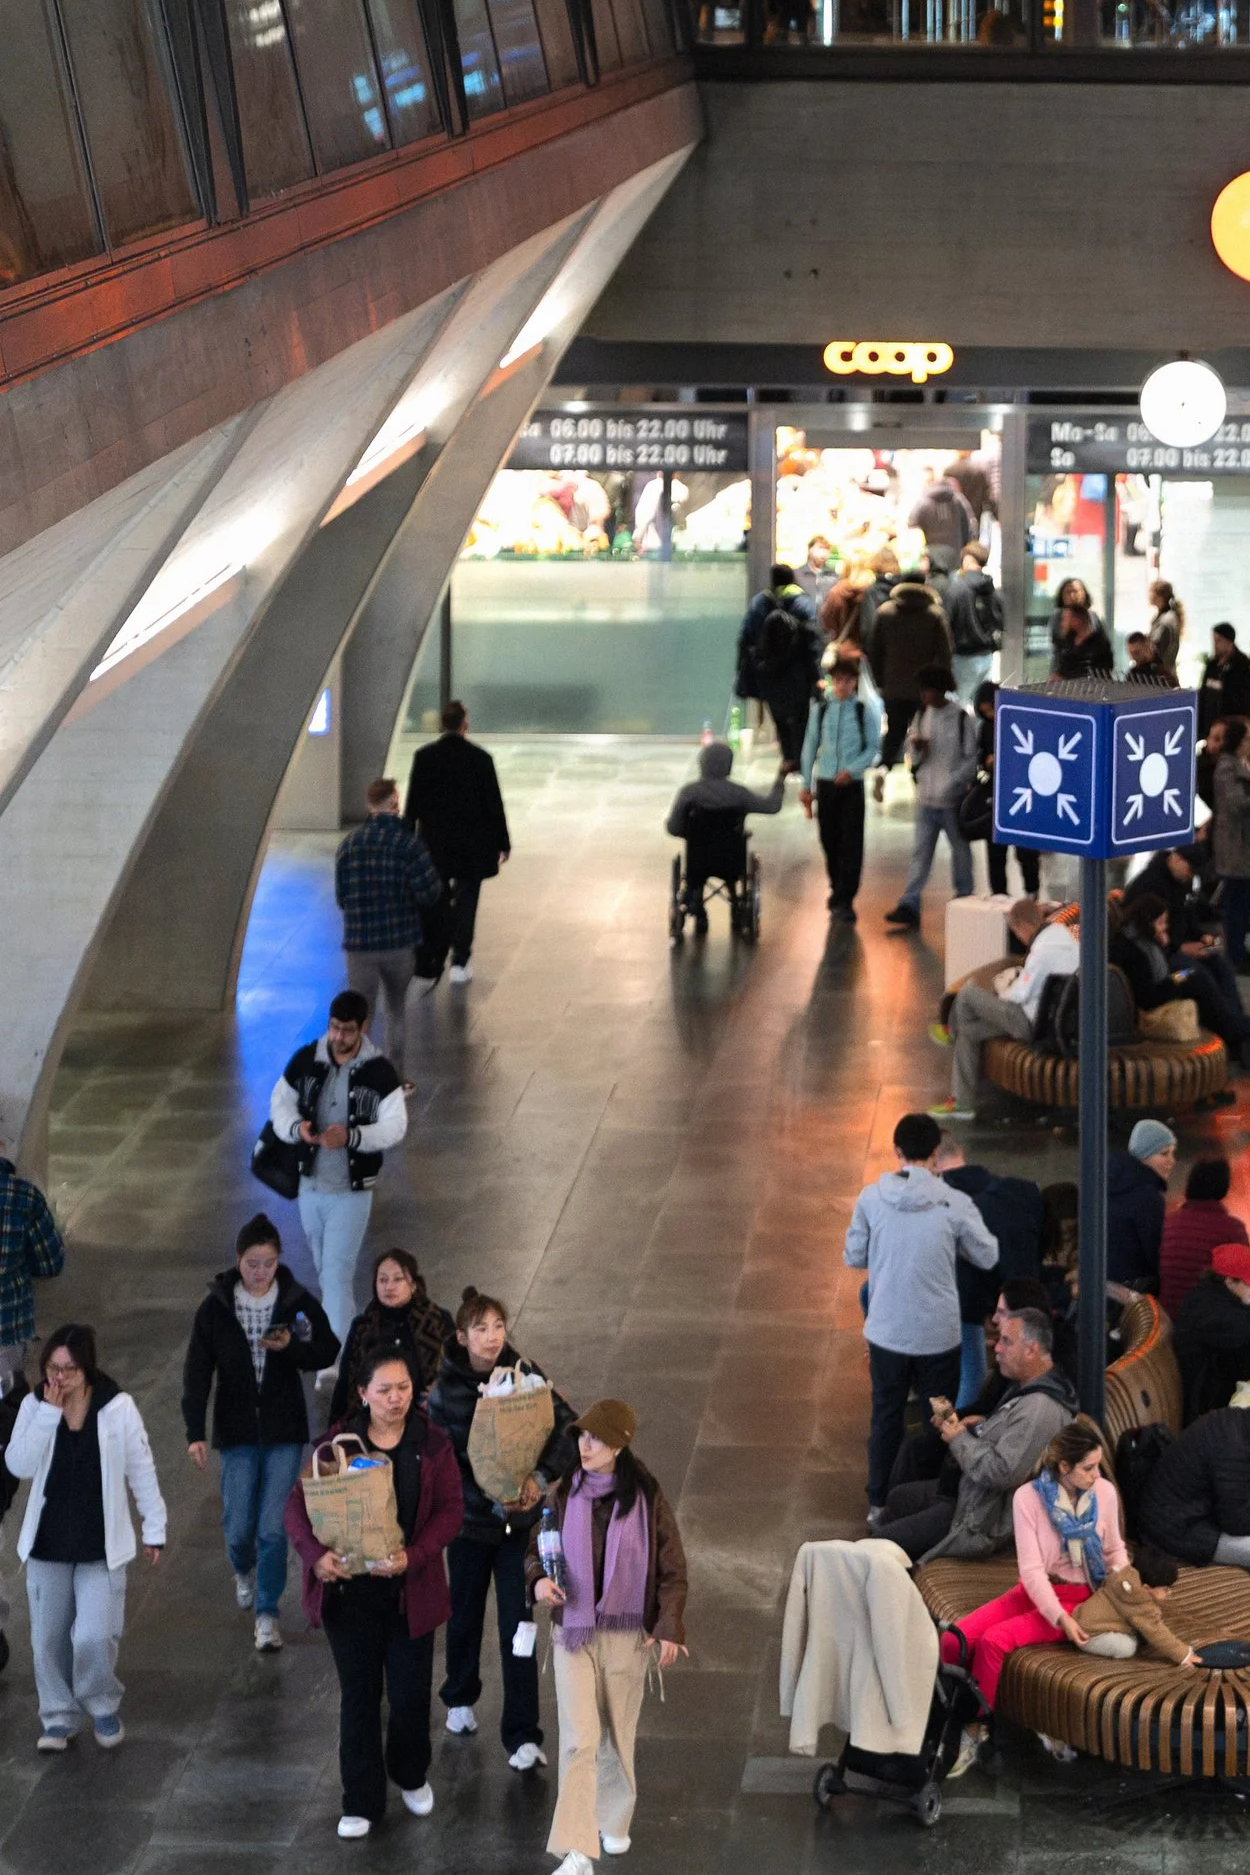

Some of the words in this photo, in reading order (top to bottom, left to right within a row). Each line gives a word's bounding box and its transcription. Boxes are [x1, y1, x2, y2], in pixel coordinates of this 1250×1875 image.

[823, 341, 954, 384] coop
[606, 419, 635, 439] bis
[636, 418, 690, 440] 22.00
[693, 419, 728, 440] Uhr
[1050, 422, 1118, 443] Mo-Sa
[550, 443, 604, 466] 07.00
[606, 445, 635, 465] bis
[636, 444, 690, 466] 22.00
[693, 445, 728, 465] Uhr
[1050, 447, 1075, 468] So
[1126, 447, 1179, 468] 07.00
[1182, 447, 1211, 467] bis
